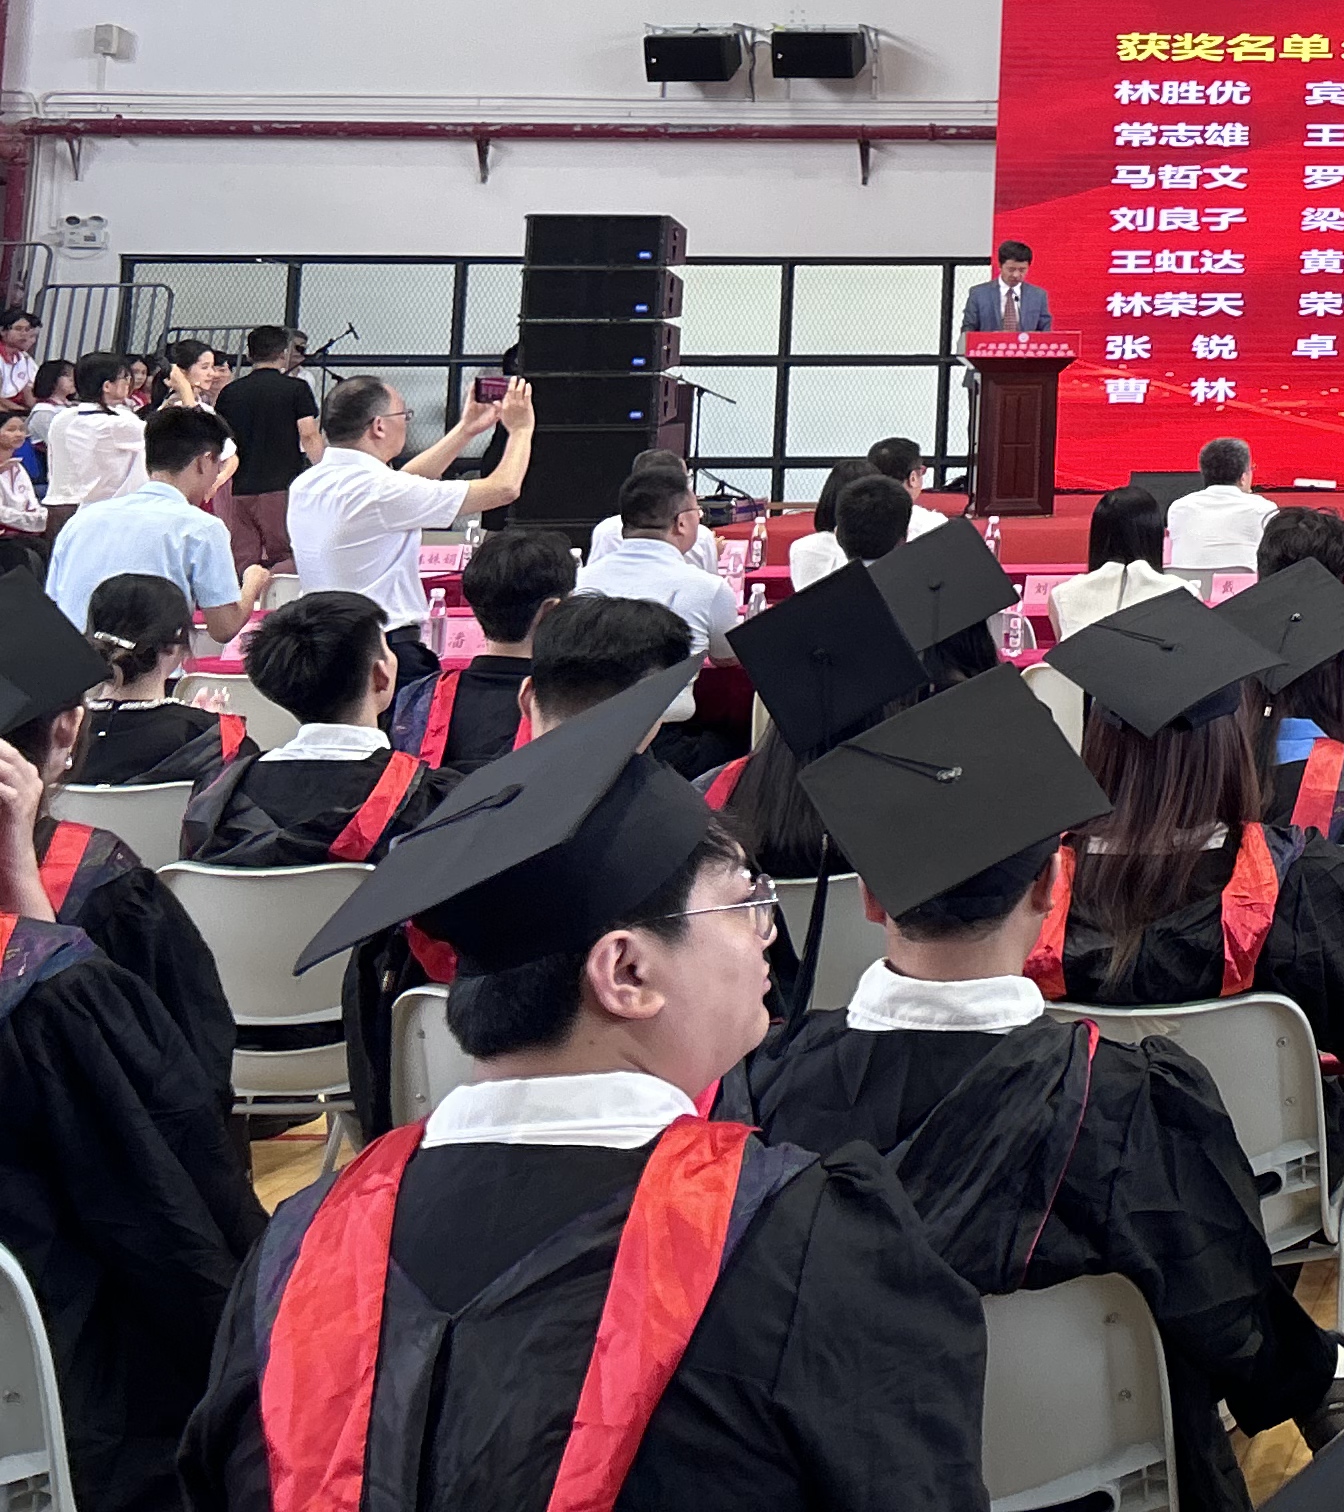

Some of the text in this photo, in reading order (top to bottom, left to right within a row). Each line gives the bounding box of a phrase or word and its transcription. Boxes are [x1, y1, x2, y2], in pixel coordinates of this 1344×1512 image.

[1114, 79, 1251, 105] 林胜优
[1113, 121, 1250, 148] 常志雄
[1111, 164, 1248, 190] 马哲文
[1109, 206, 1247, 232] 刘良子
[1108, 249, 1245, 274] 王虹达
[1106, 291, 1244, 318] 林荣天
